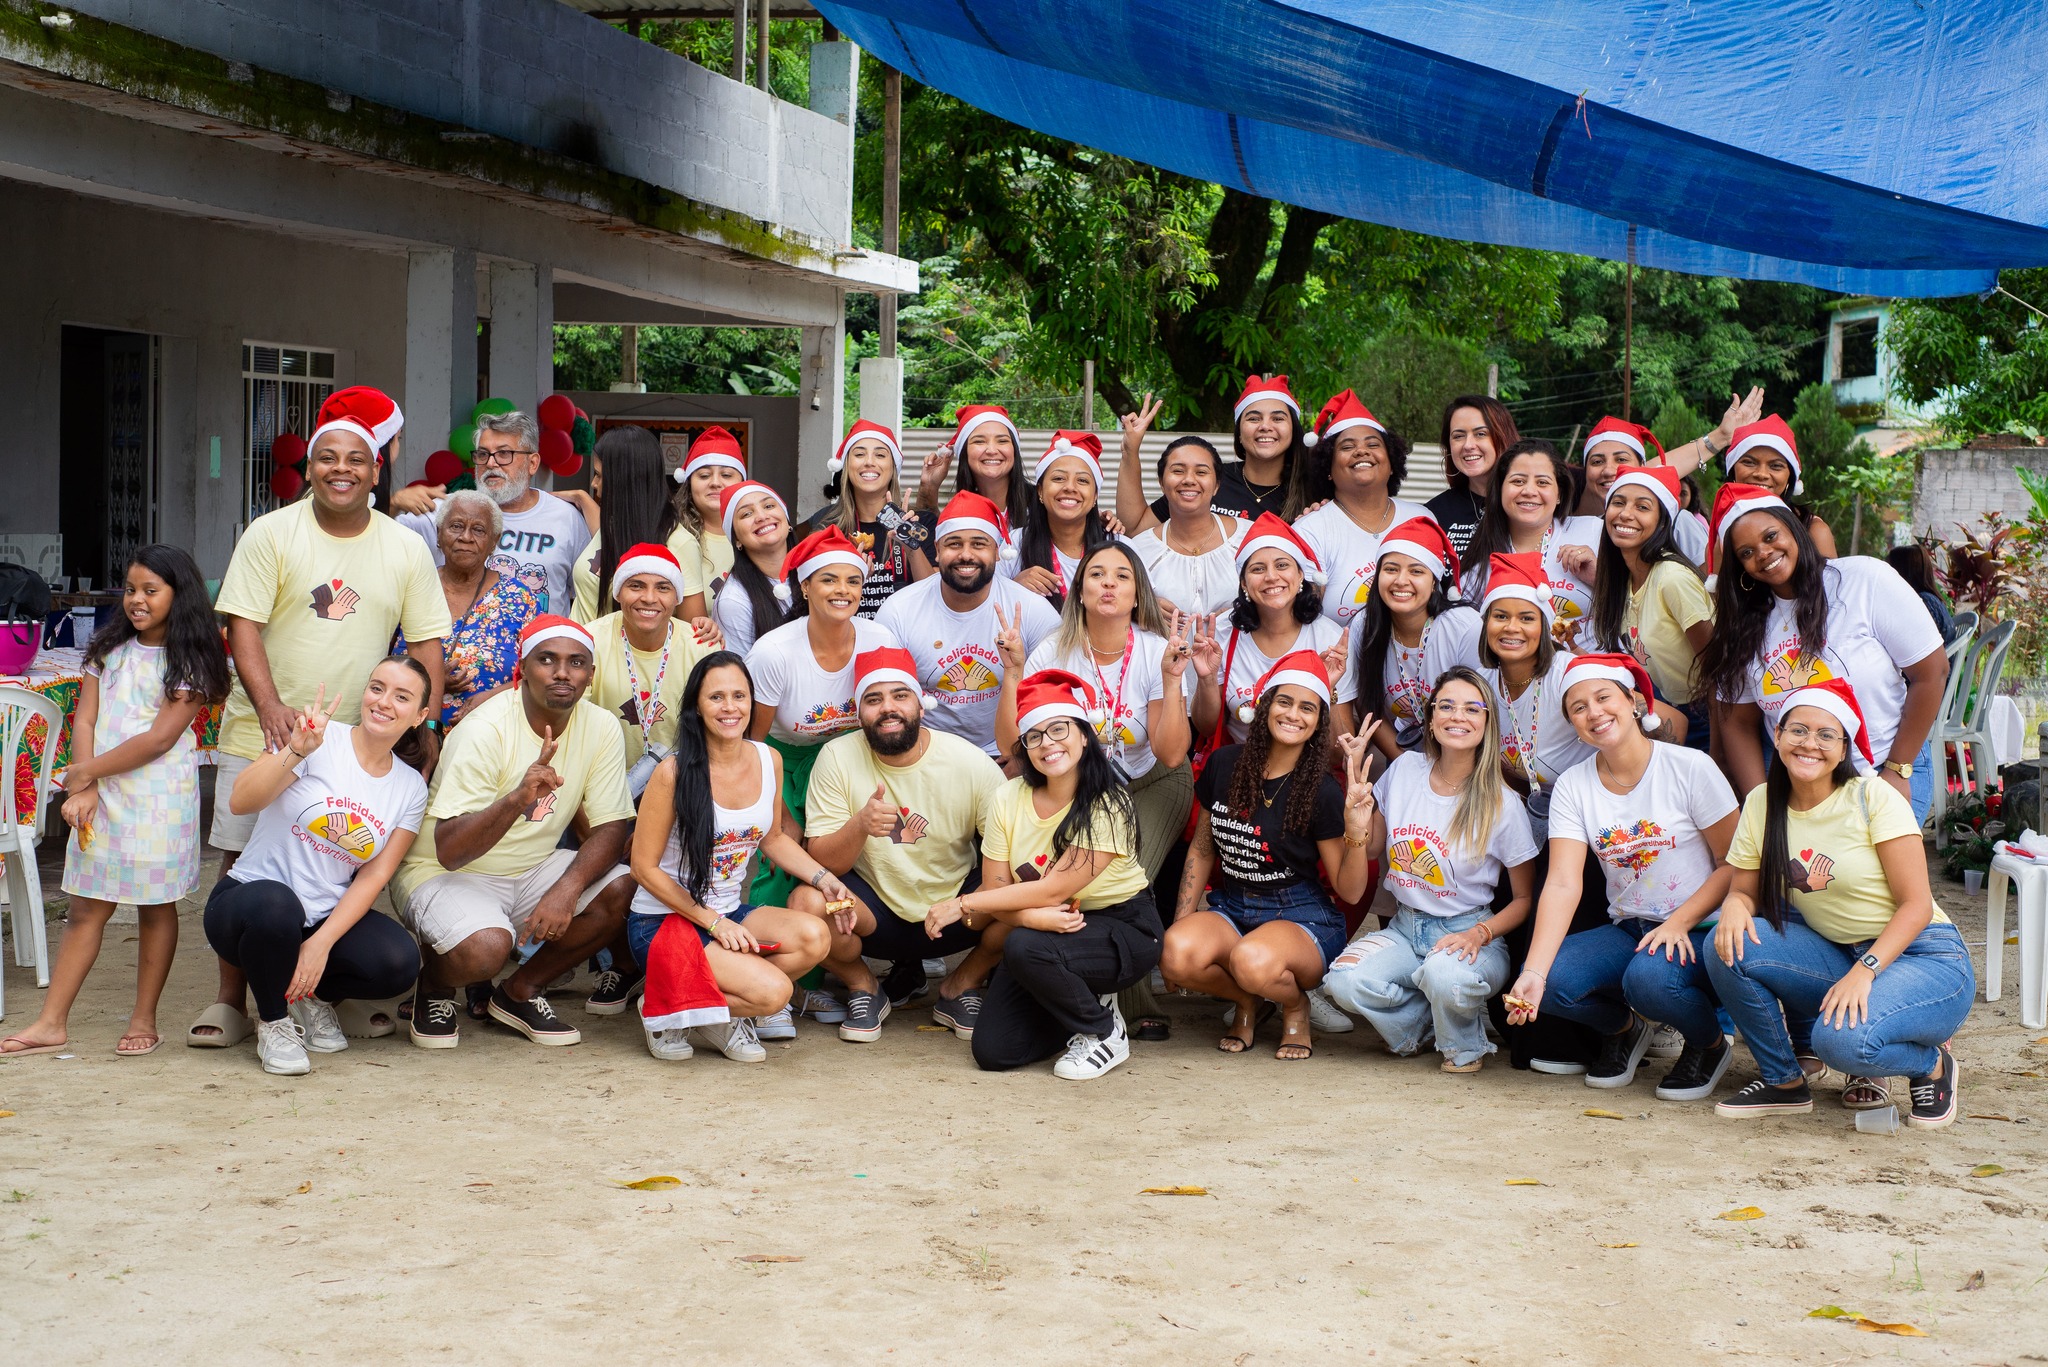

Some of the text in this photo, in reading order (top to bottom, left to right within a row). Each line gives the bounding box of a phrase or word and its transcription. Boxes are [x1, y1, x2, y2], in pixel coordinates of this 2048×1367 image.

[1210, 504, 1249, 519] Amor&
[497, 529, 556, 554] CITP
[1447, 531, 1473, 539] Igual
[937, 643, 999, 669] Felicidade
[1764, 634, 1803, 664] Felici
[925, 684, 1002, 705] ompartilhad
[326, 796, 386, 837] Felicidade
[1210, 813, 1262, 836] Igualdade&
[291, 825, 362, 867] Compartilha
[1211, 826, 1269, 852] Diversidade&
[1393, 824, 1450, 858] Felicidade
[1386, 873, 1457, 898] mpartilhada
